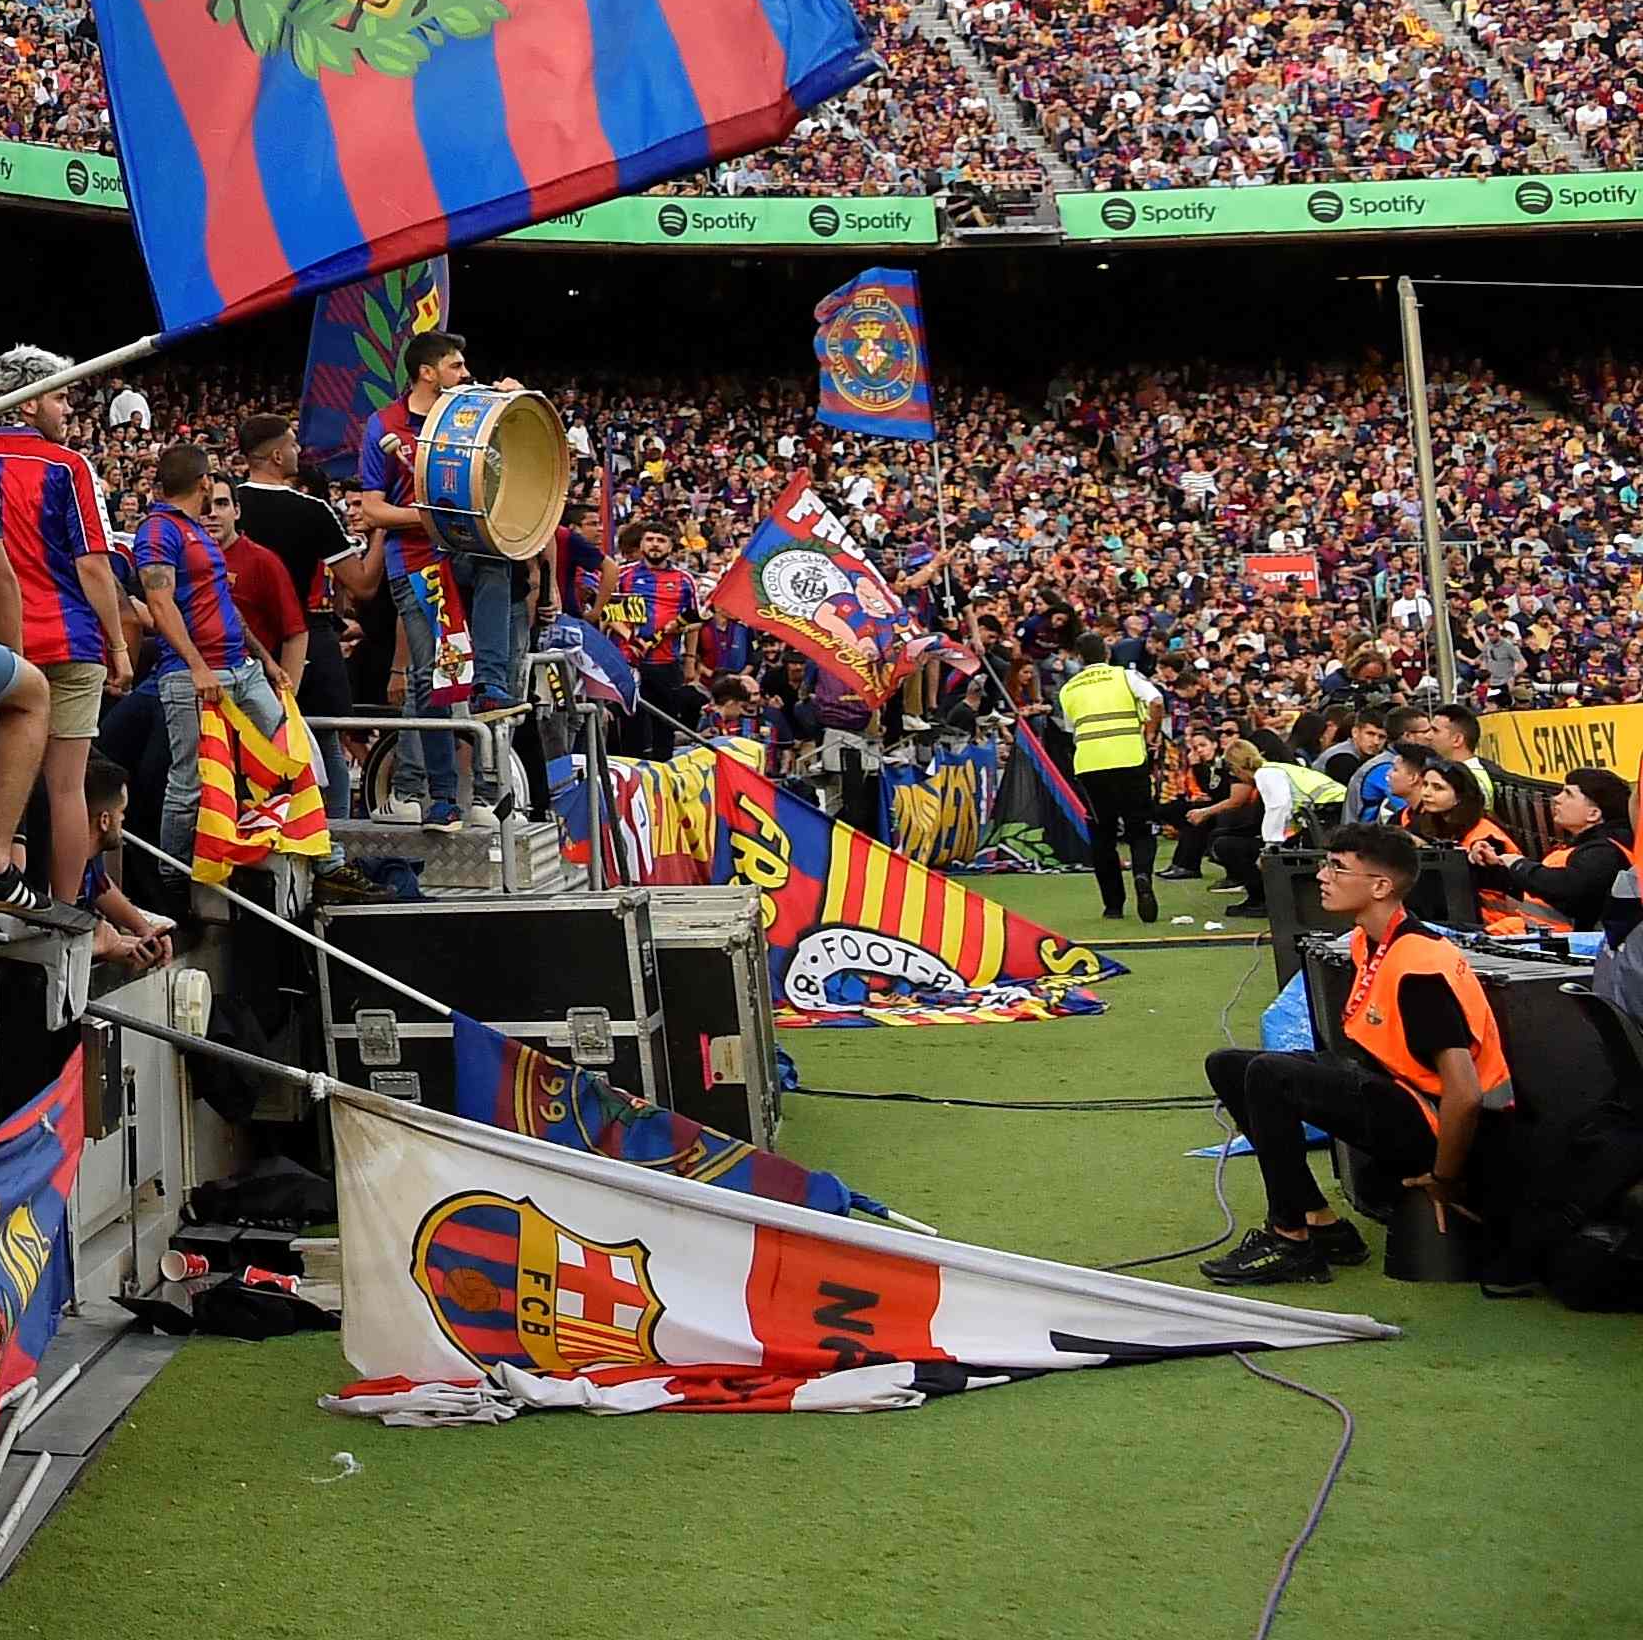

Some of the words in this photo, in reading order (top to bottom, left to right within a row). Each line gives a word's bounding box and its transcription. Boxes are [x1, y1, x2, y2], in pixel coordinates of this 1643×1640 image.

[92, 171, 124, 193] Spot
[1349, 194, 1426, 215] Spotify
[1559, 185, 1637, 208] Spotify
[691, 212, 757, 232] Spotify
[844, 212, 912, 233] Spotify
[1141, 202, 1217, 224] Spotify
[1532, 721, 1617, 776] STANLEY
[520, 1268, 552, 1339] FCB
